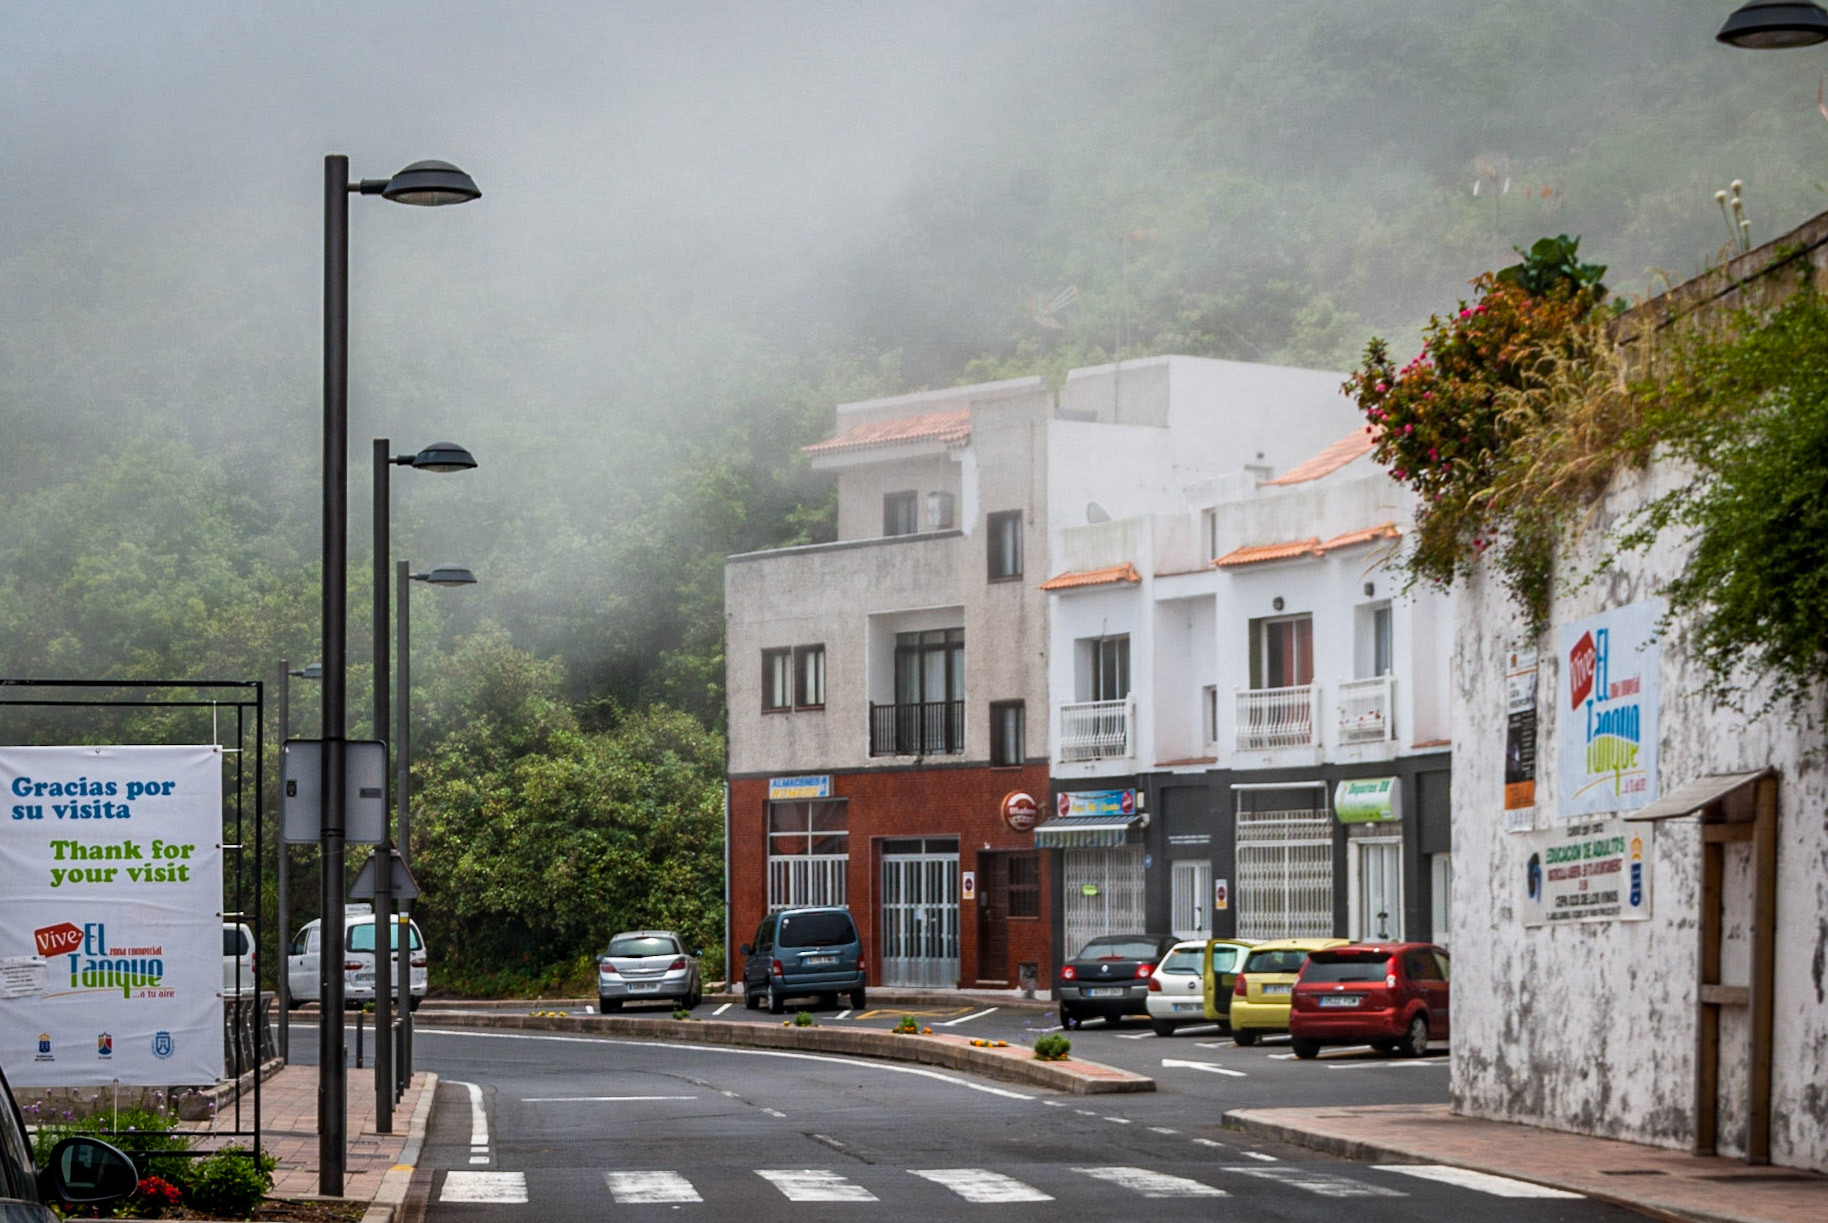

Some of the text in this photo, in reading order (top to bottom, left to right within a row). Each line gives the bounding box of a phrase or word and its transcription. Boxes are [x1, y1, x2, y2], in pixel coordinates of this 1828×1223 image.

[1586, 699, 1640, 797] Tanque
[11, 777, 176, 801] Gracias por
[11, 799, 131, 820] su visita
[50, 839, 196, 860] Thank for
[50, 862, 190, 888] your visit
[37, 930, 80, 950] Vive
[84, 923, 108, 956] El
[109, 945, 162, 956] zona comercial
[67, 953, 164, 999] Tanque
[147, 988, 156, 998] tu
[158, 988, 175, 998] aire
